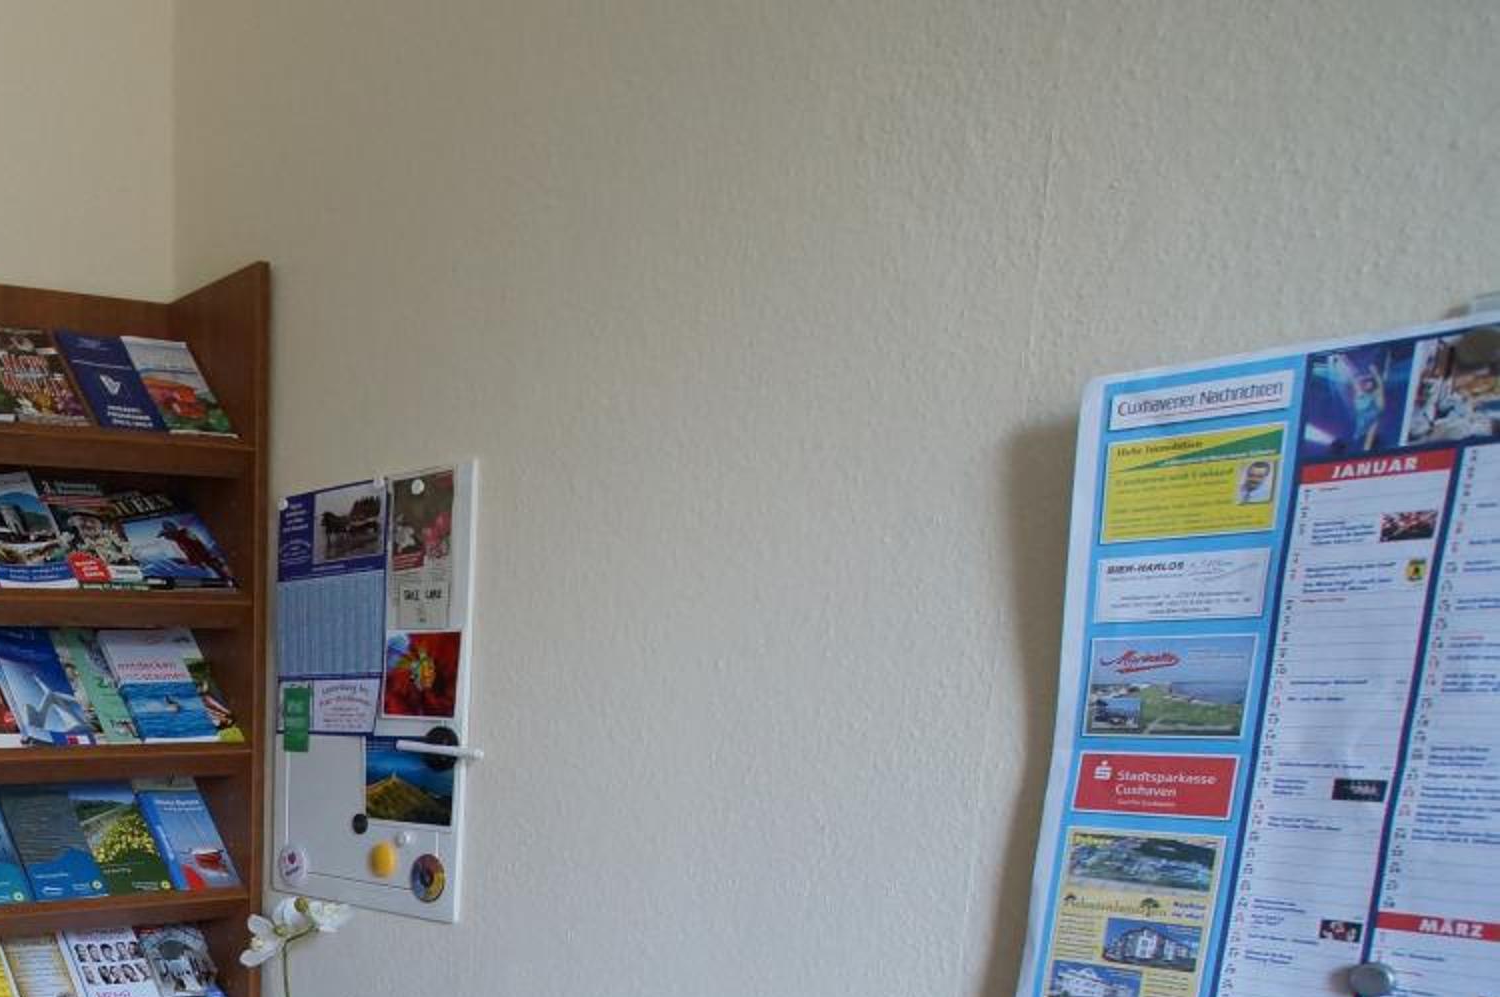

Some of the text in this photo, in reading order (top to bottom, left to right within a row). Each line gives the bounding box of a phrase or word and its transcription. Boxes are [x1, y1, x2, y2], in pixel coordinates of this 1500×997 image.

[1116, 381, 1285, 417] Cuxhavener Nachrichten
[1331, 456, 1419, 480] JANUAR
[1116, 770, 1219, 787] Stadtsparkasse
[1114, 784, 1177, 798] Cuxhaven
